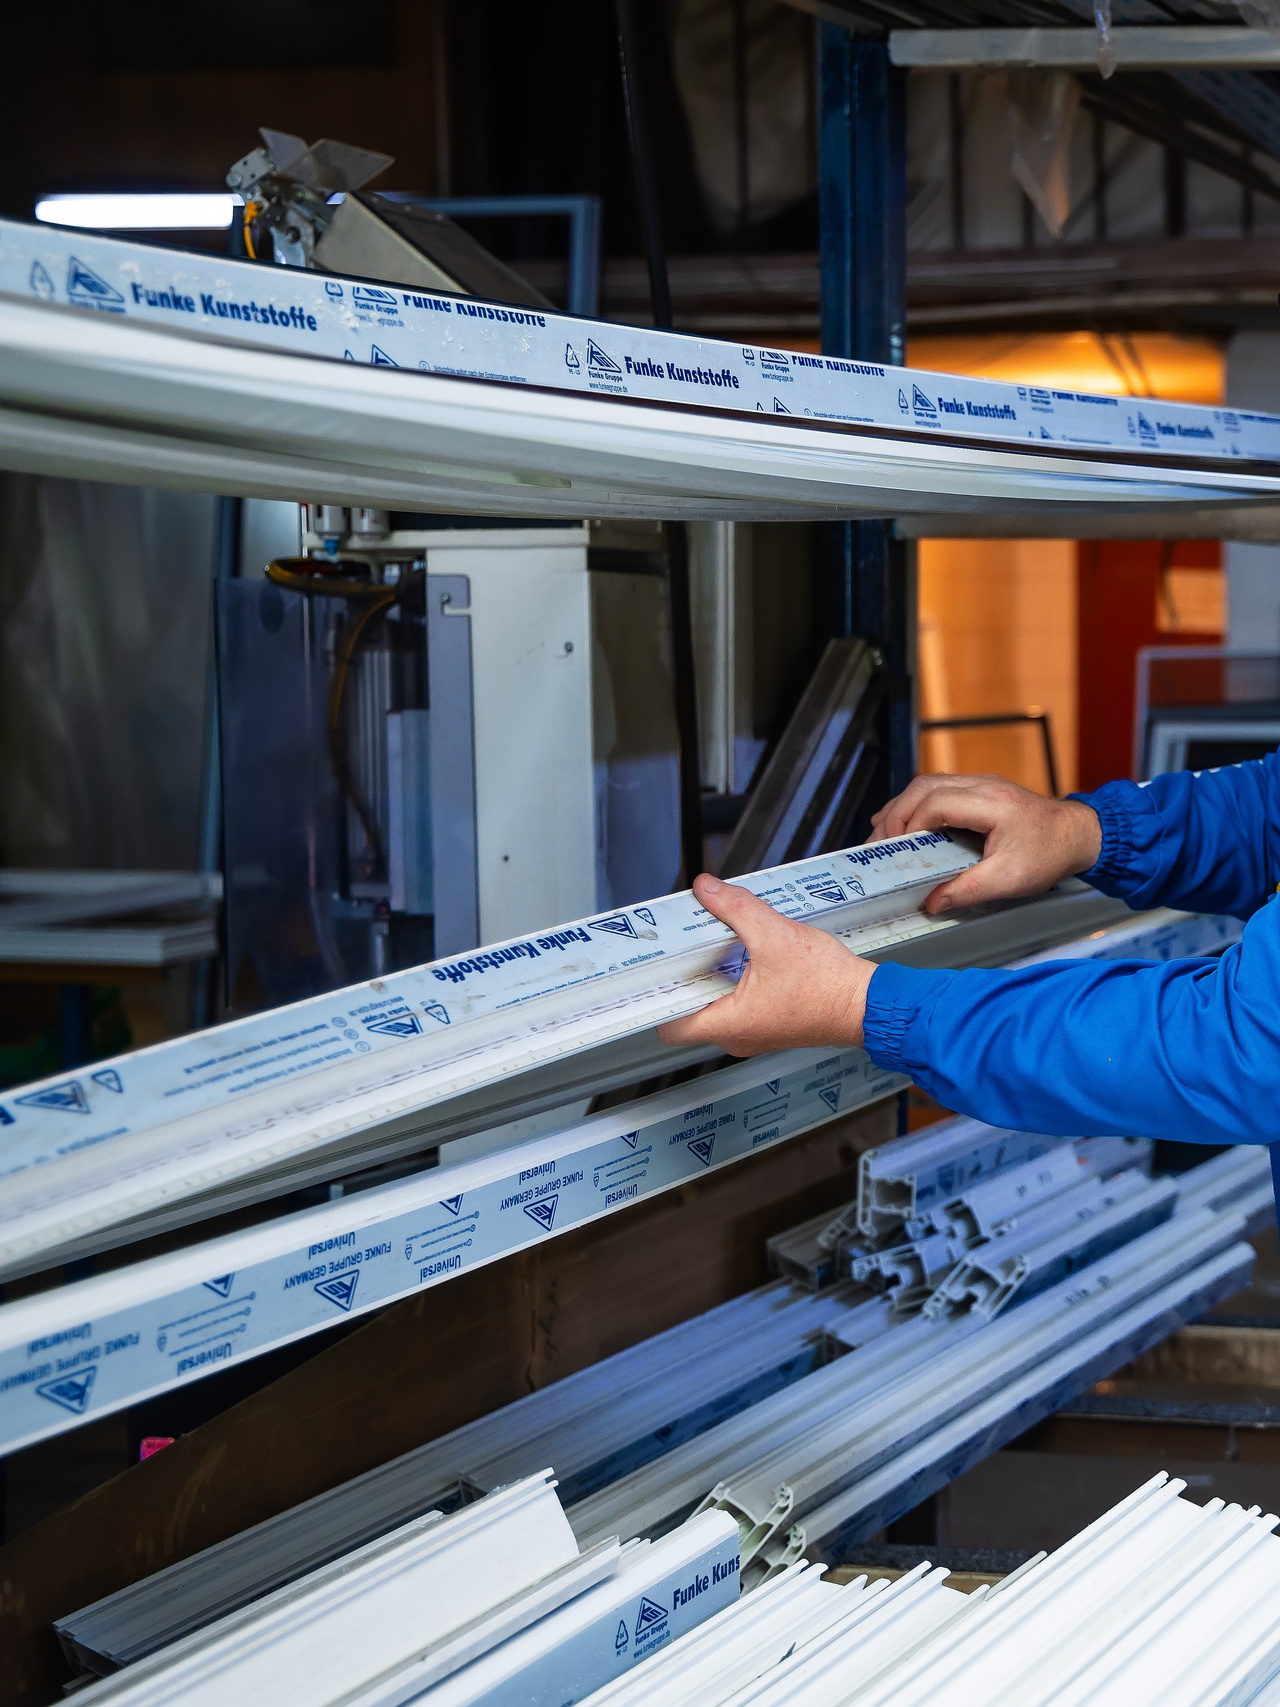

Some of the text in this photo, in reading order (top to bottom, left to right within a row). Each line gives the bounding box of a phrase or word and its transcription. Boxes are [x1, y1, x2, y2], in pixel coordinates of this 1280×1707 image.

[131, 281, 195, 313] Funke
[200, 293, 317, 331] Kunststoffe
[624, 355, 740, 389] Funke Kunststoffe
[938, 397, 1017, 420] Funke Kunststoffe
[847, 839, 920, 866] Kunststoffe
[432, 927, 592, 984] Funke Kunststoffe
[683, 1103, 714, 1124] Universal
[718, 1112, 736, 1127] FUNKE
[668, 1128, 696, 1146] GERMANY
[696, 1119, 718, 1136] GRUPPE
[752, 1126, 779, 1147] Universal
[518, 1160, 556, 1185] Universal
[499, 1170, 584, 1211] FUNKE GRUPPE GERMANY
[605, 1183, 638, 1208] Universal
[308, 1231, 355, 1260] Universal
[283, 1241, 392, 1290] FUNKE GRUPPE GERMANY
[419, 1254, 461, 1283] Universal
[177, 1342, 232, 1376] Universal
[673, 1554, 740, 1611] Funke Kuns
[650, 1620, 668, 1637] Gruppe
